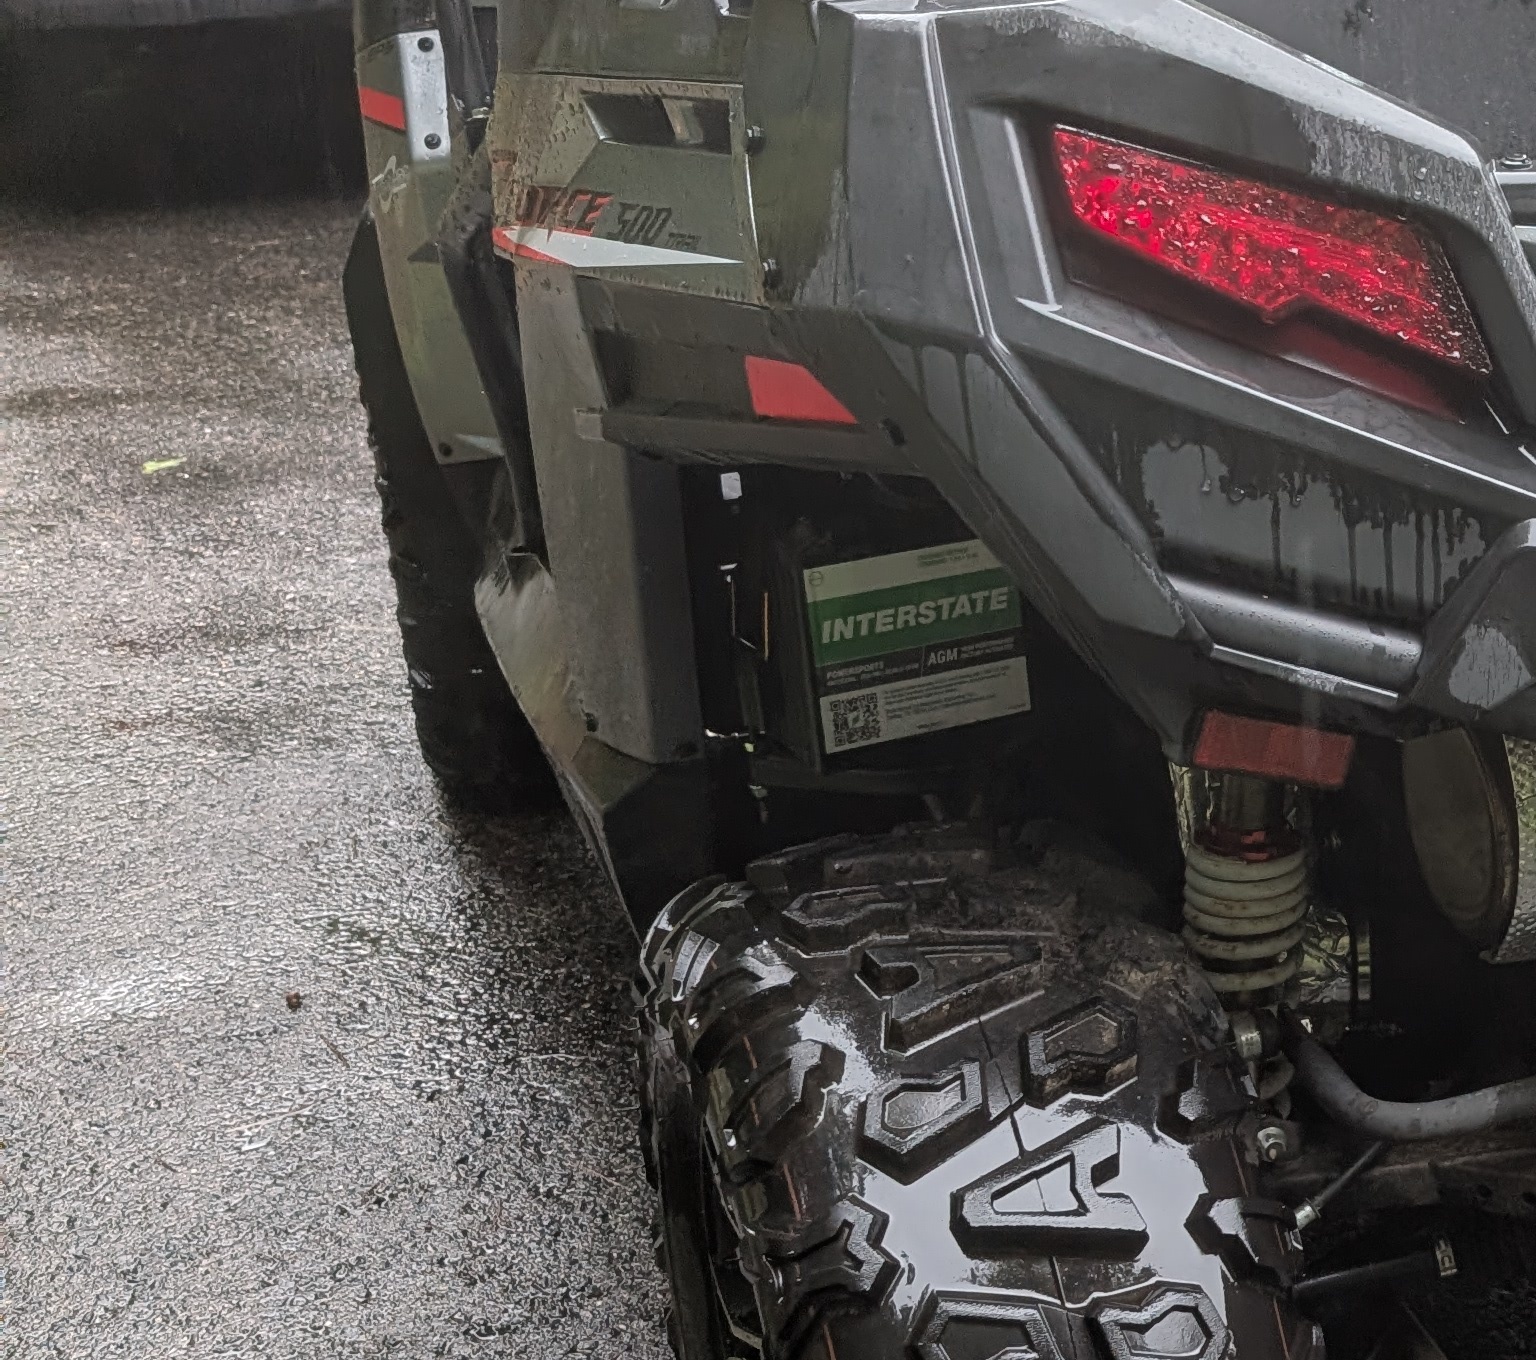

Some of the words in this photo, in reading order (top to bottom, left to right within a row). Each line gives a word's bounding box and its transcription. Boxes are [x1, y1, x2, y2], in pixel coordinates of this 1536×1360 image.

[607, 200, 673, 246] 500
[820, 586, 1009, 644] INTERSTATE
[927, 647, 958, 666] AGM
